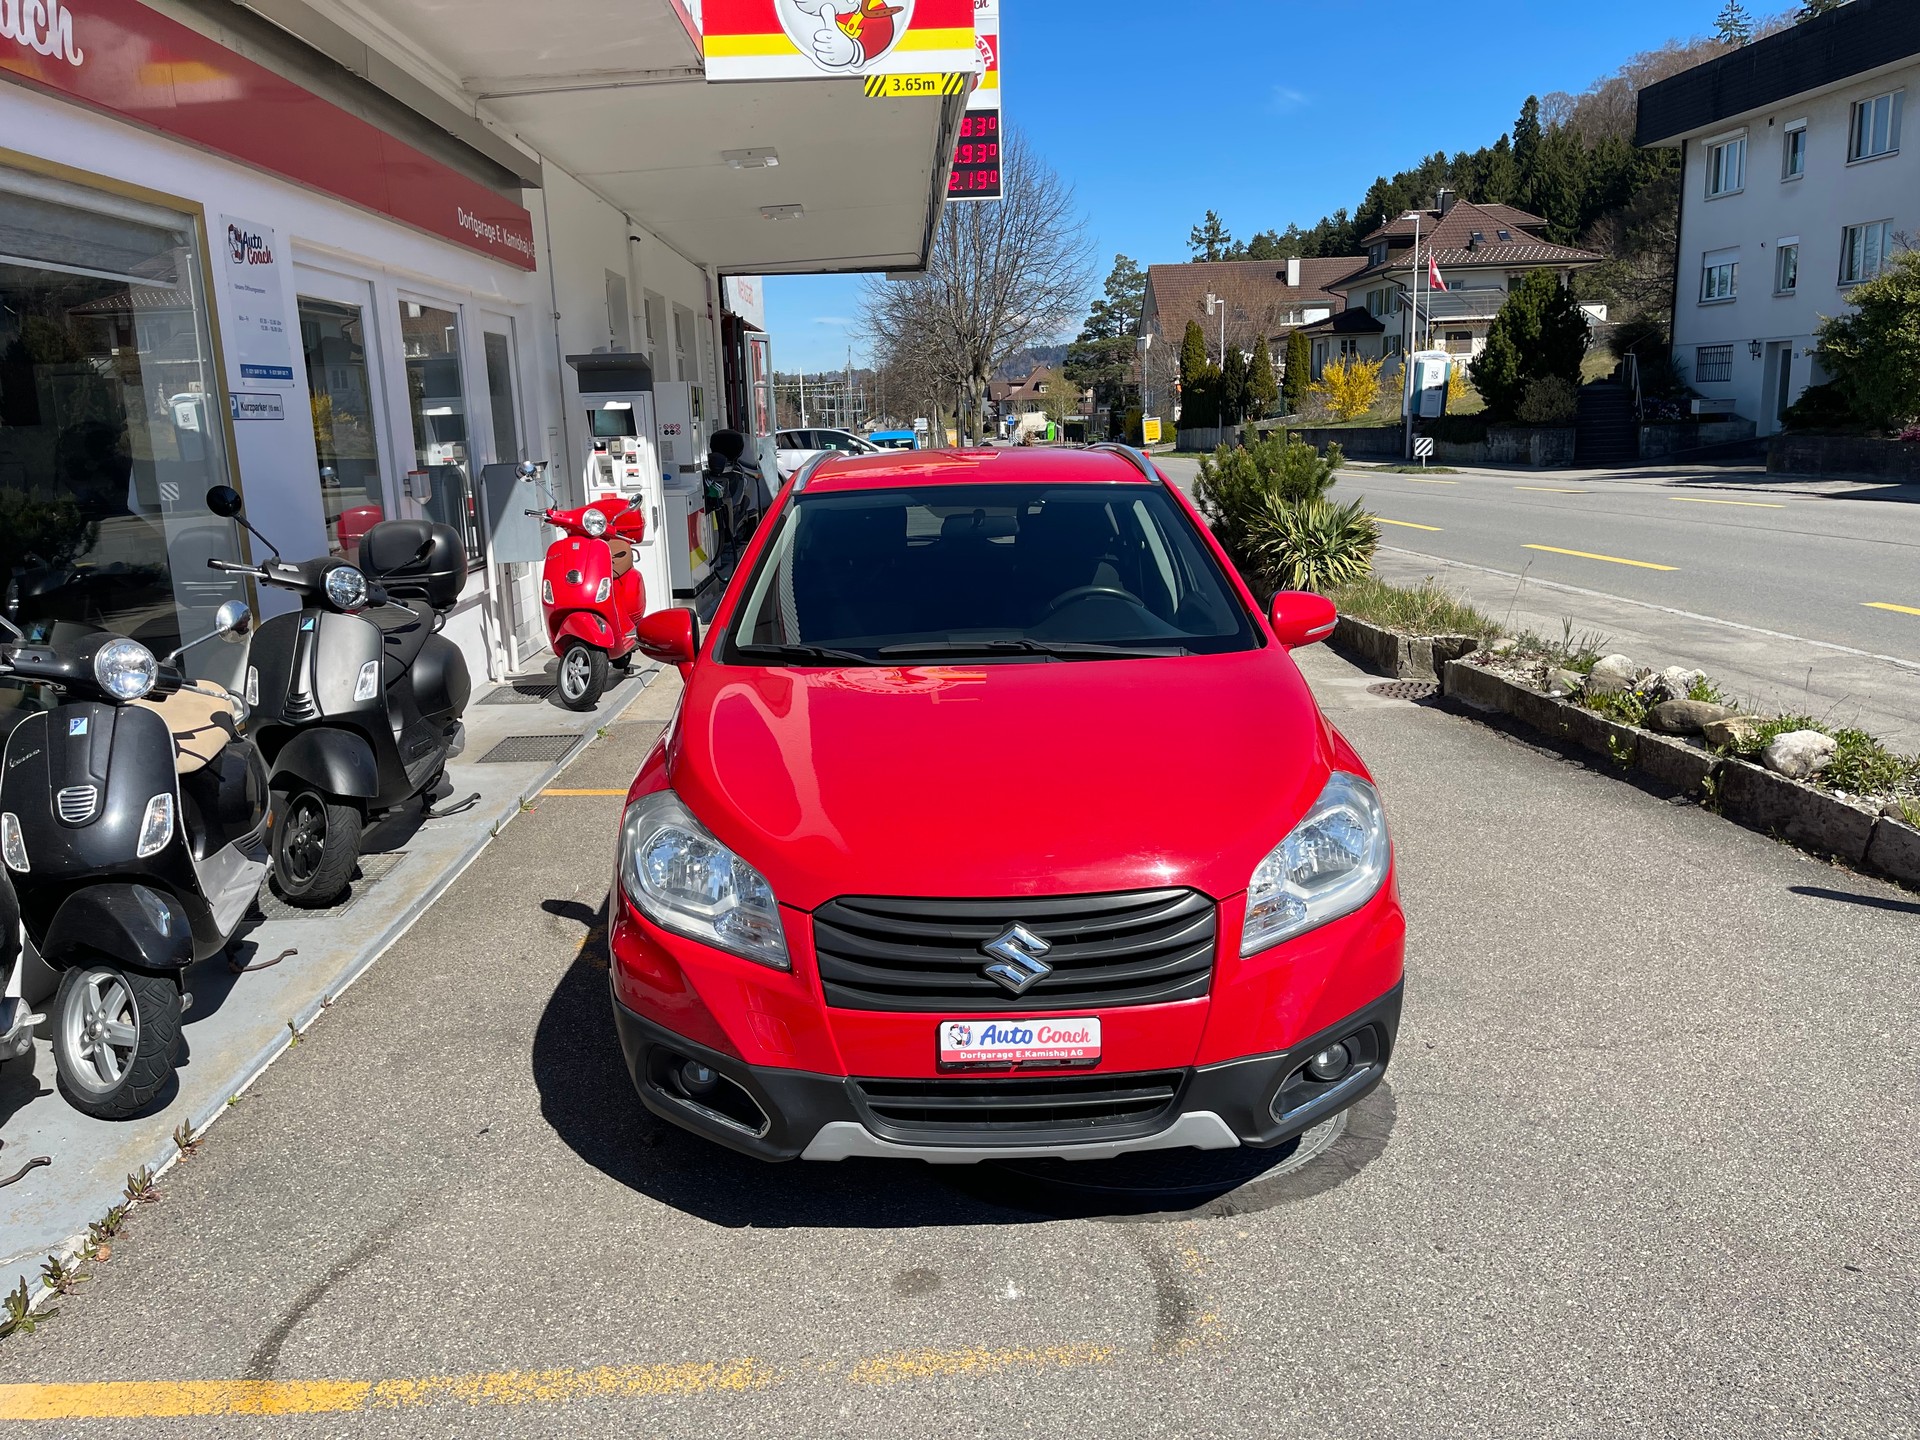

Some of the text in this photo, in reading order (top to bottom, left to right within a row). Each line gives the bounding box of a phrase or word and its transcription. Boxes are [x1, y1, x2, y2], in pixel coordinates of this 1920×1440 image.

[975, 35, 993, 65] SEL
[893, 78, 935, 91] 3.65m
[243, 231, 262, 249] Auto
[457, 206, 496, 243] Dorfgarage
[496, 225, 502, 242] E.
[503, 228, 529, 258] Kamishaj
[247, 245, 273, 265] Coach
[240, 402, 267, 413] Kurzparker
[979, 1024, 1091, 1046] Auto Coach
[960, 1051, 1013, 1060] Dorfgarage
[1070, 1049, 1084, 1057] AG
